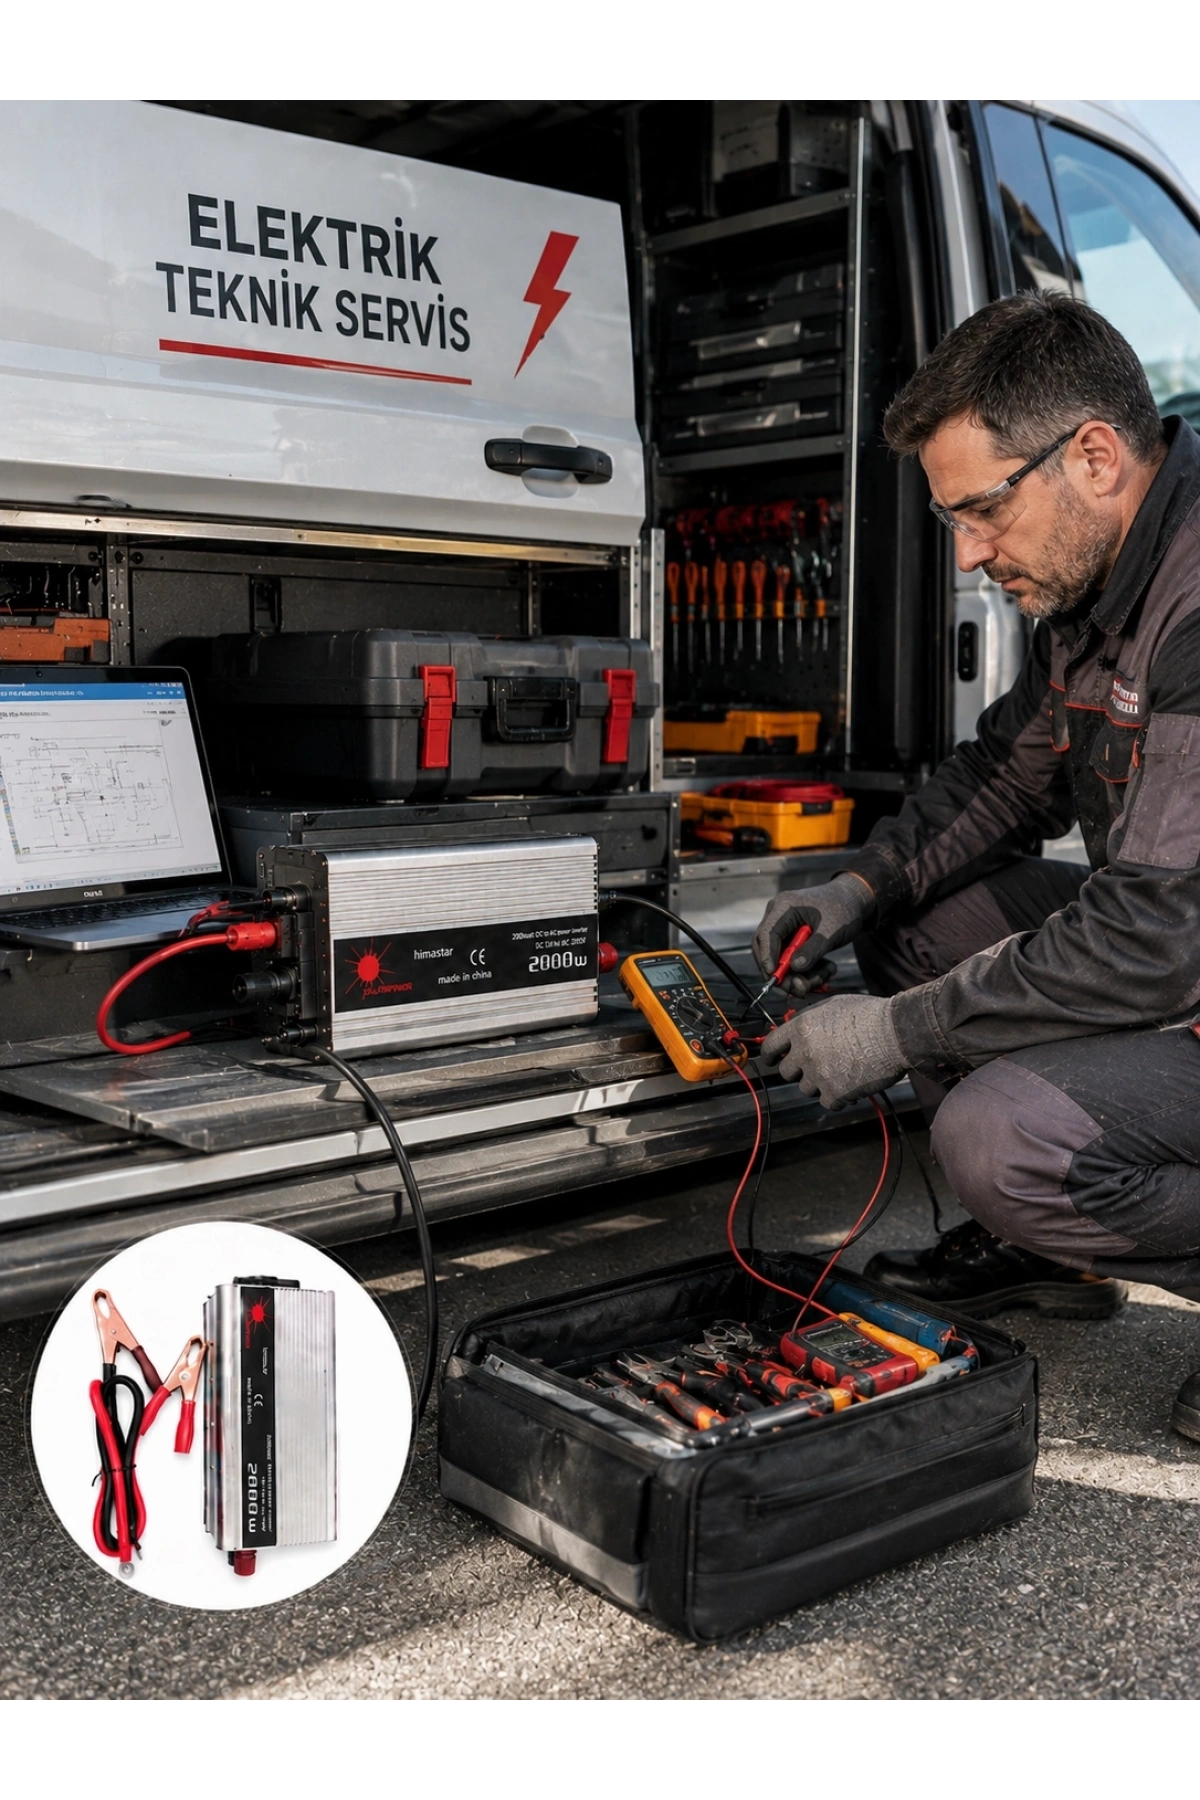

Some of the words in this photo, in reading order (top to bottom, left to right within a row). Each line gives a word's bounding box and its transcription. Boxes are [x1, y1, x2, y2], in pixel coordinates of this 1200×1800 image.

[187, 192, 442, 285] ELEKTRİK
[155, 261, 323, 332] TEKNİK
[335, 289, 471, 353] SERVİS
[413, 948, 454, 961] himastar
[470, 948, 486, 966] CE
[438, 973, 460, 985] made
[462, 972, 470, 981] in
[472, 970, 493, 981] china
